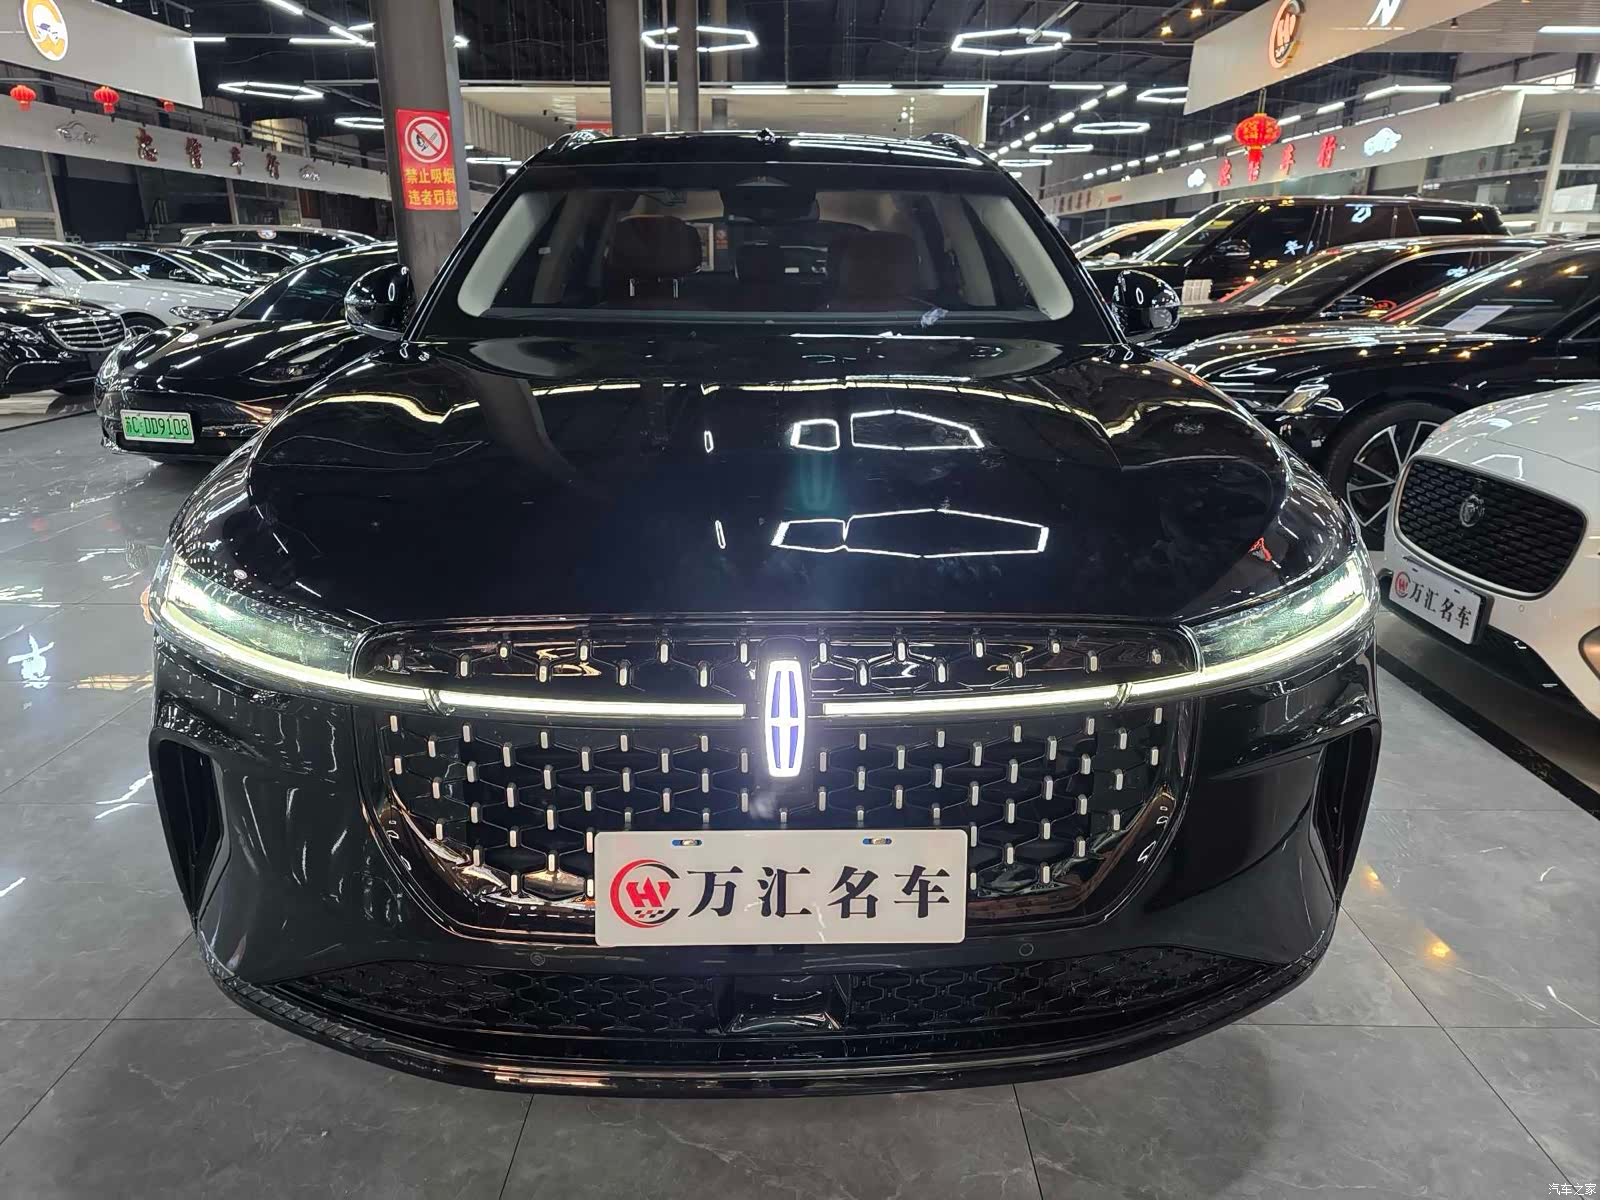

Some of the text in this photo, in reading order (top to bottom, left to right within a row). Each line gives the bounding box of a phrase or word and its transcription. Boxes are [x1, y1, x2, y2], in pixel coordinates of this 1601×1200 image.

[405, 167, 456, 184] 禁止吸烟
[408, 189, 459, 206] 违者罚款
[1409, 582, 1472, 629] 万汇名车
[687, 865, 951, 919] 万汇名车
